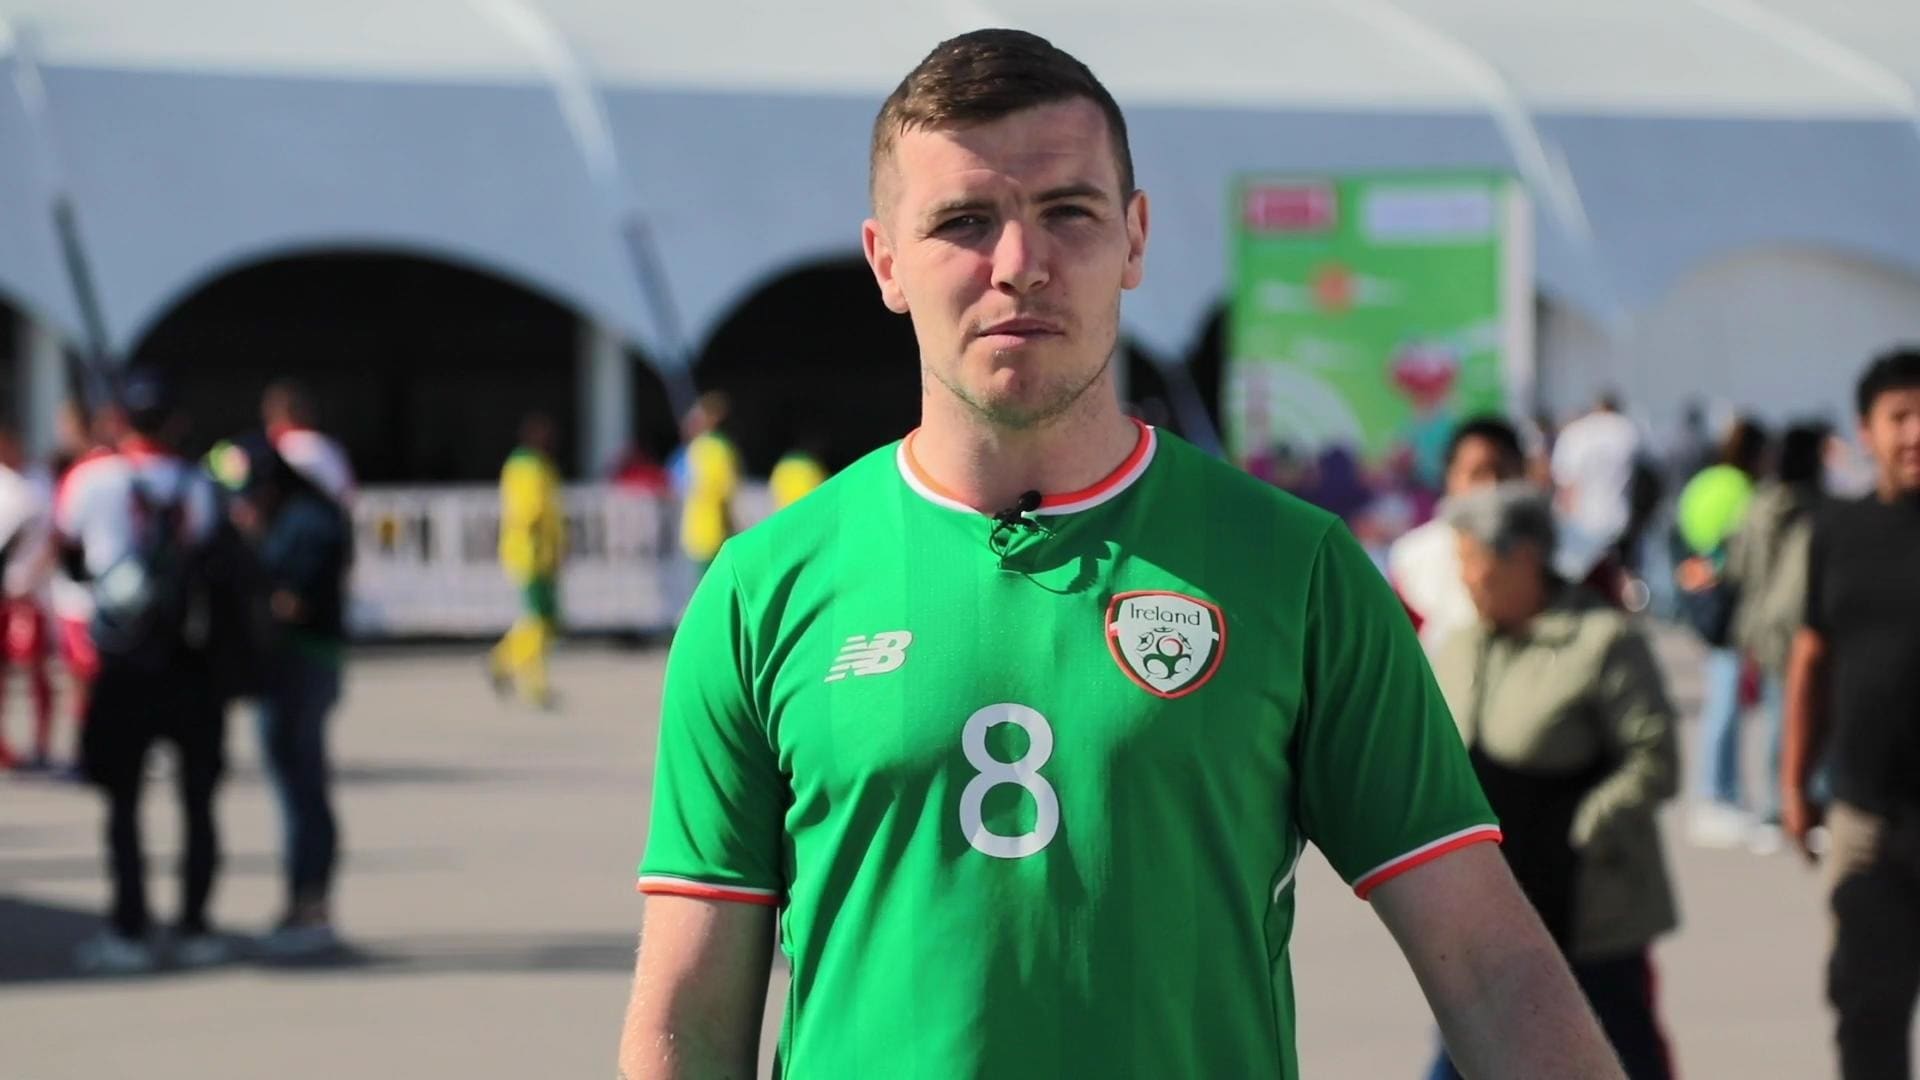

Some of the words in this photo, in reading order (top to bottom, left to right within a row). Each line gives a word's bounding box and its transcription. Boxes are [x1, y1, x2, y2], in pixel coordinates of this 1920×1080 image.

[1130, 603, 1201, 626] Ireland
[825, 631, 913, 682] NB
[959, 702, 1060, 859] 8
